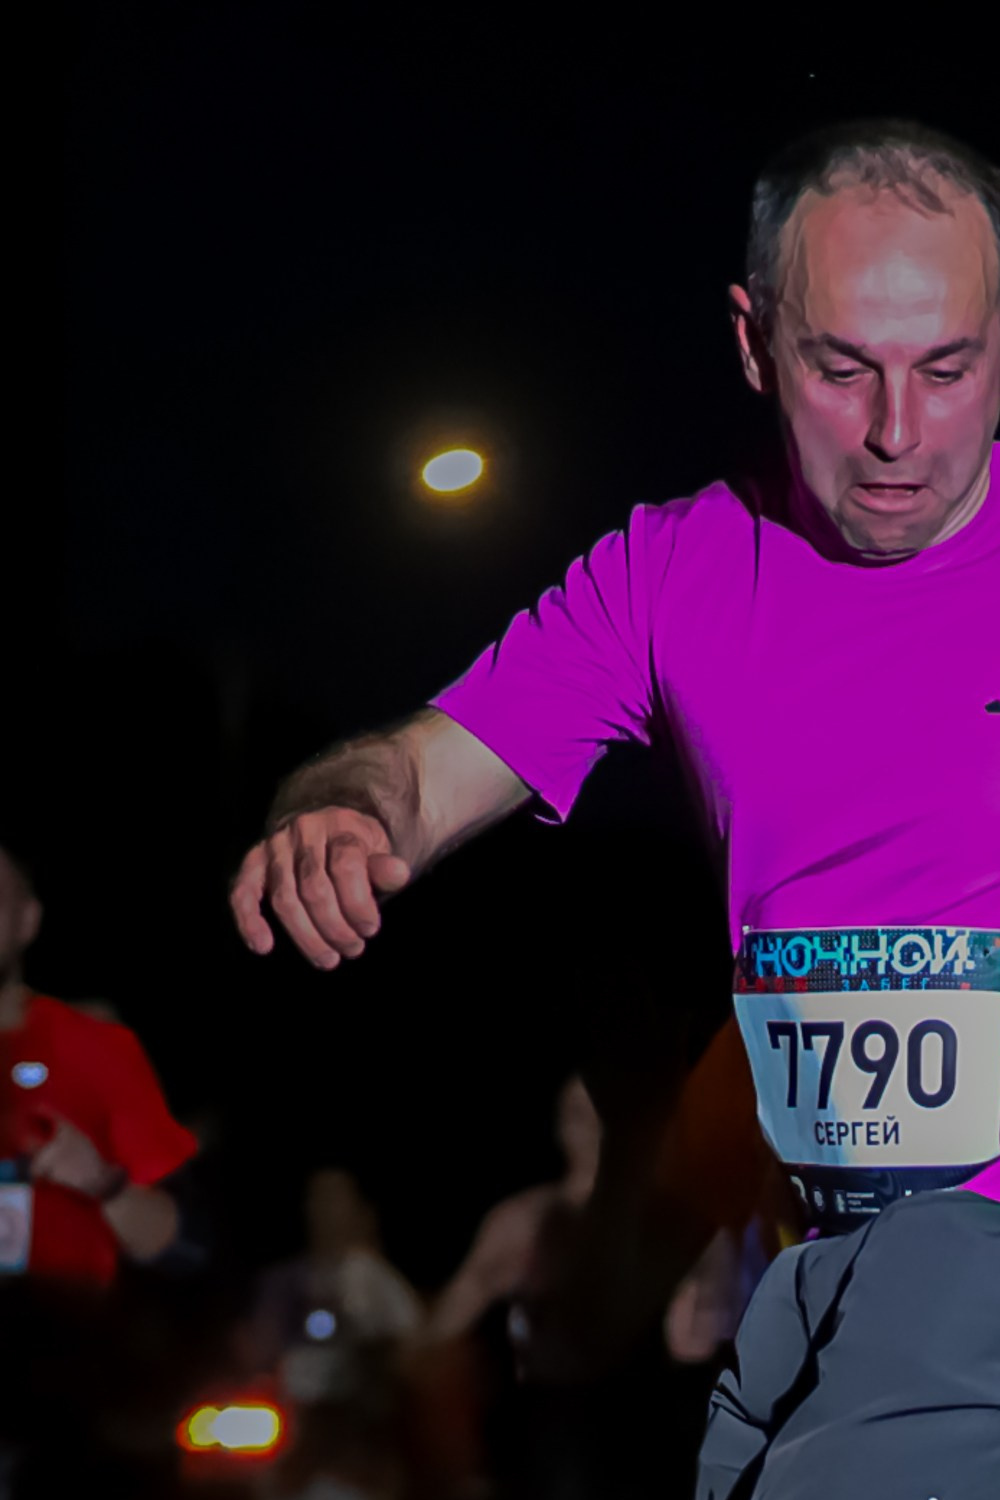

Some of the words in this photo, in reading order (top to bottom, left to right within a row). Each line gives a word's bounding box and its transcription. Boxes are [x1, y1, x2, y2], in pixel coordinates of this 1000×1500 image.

[753, 930, 976, 977] НОЧНОЙ
[767, 1019, 958, 1109] 7790
[814, 1115, 900, 1146] СЕРГЕЙ
